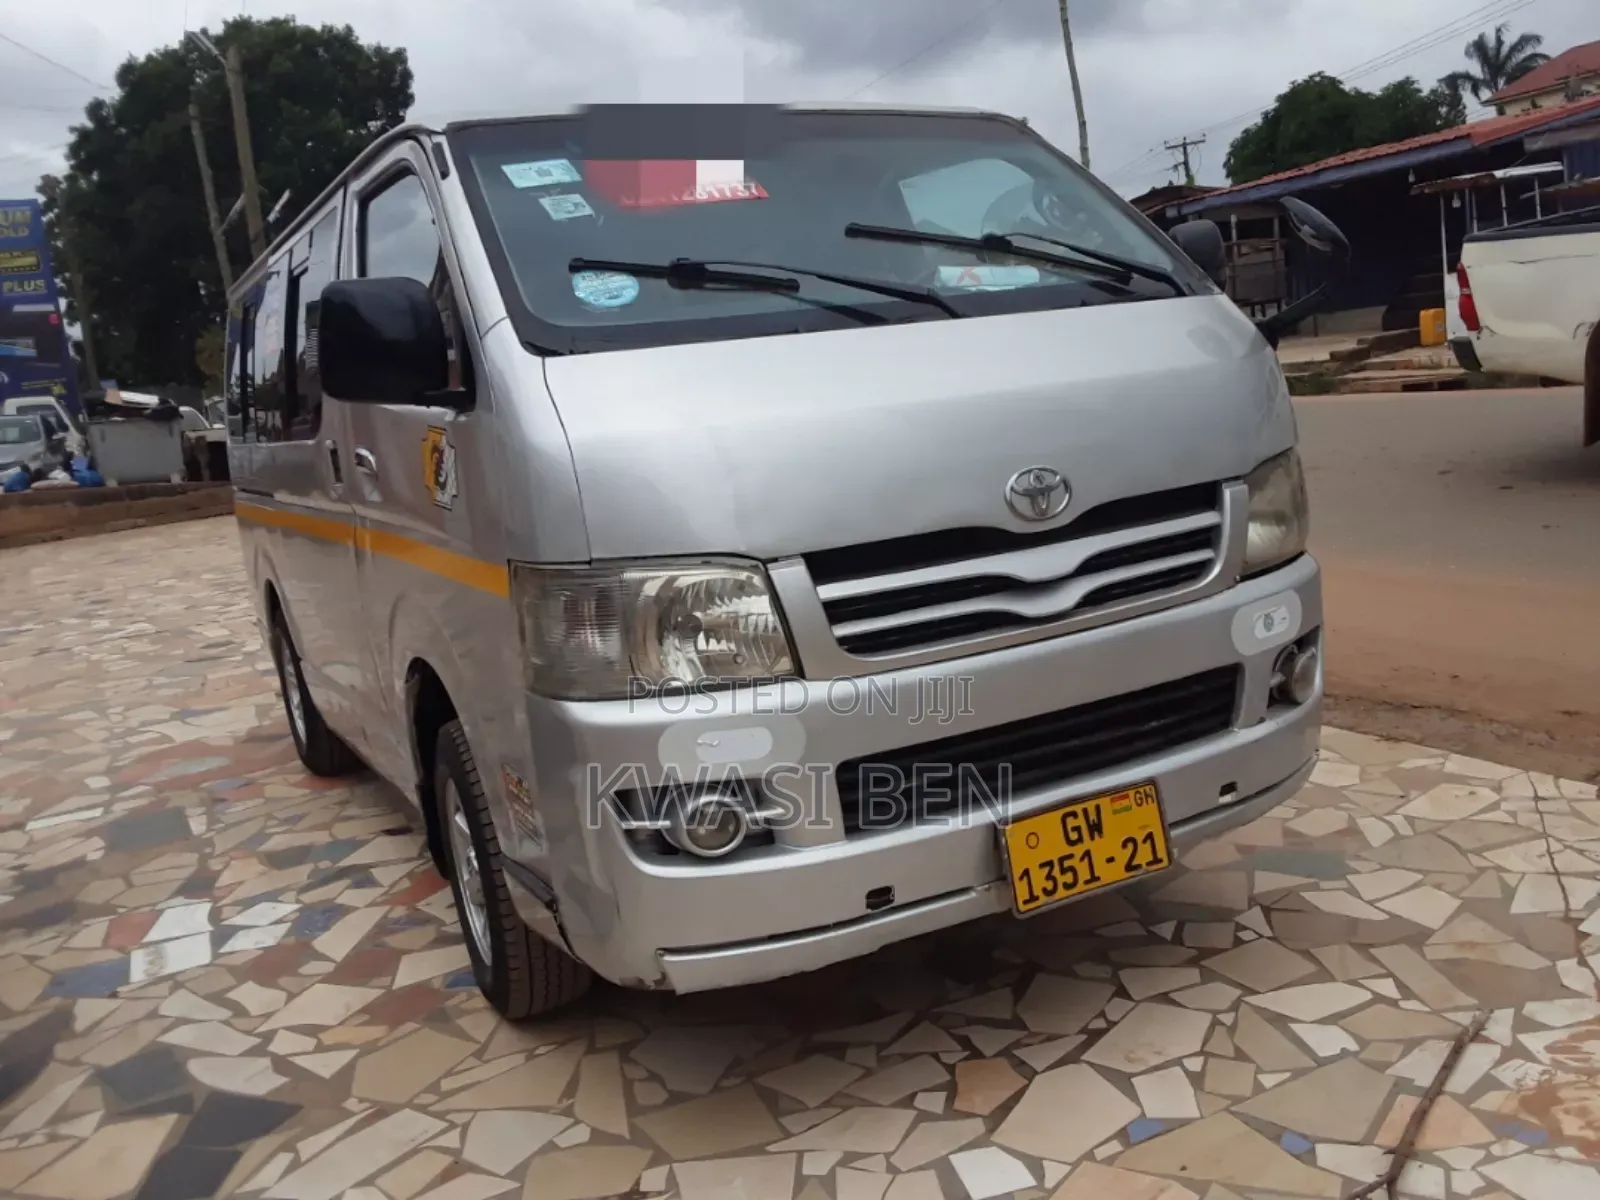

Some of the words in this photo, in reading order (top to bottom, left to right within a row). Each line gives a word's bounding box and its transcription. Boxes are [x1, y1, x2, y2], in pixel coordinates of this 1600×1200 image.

[3, 279, 46, 292] PLUS
[1060, 803, 1104, 847] GW
[1133, 786, 1155, 808] GH
[1018, 831, 1164, 905] 1351-21
